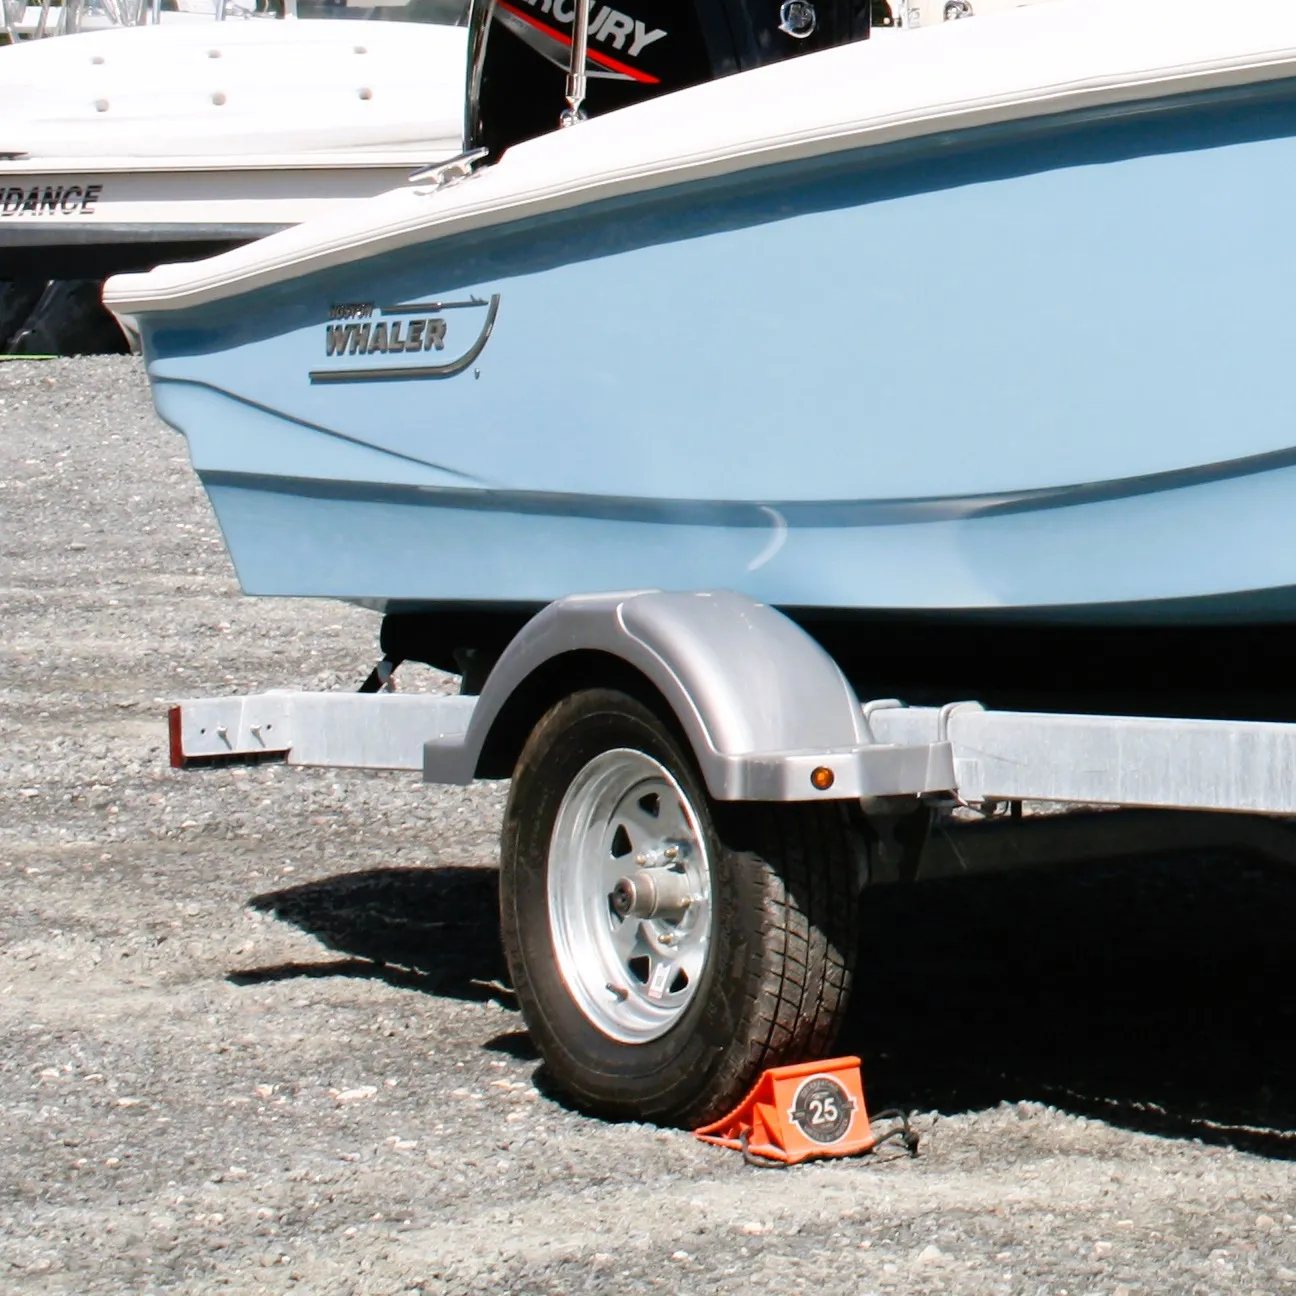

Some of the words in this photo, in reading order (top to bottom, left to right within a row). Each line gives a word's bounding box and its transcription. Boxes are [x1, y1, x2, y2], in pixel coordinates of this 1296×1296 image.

[0, 184, 103, 216] DANCE
[326, 318, 447, 357] WHALER
[809, 1096, 839, 1125] 25
